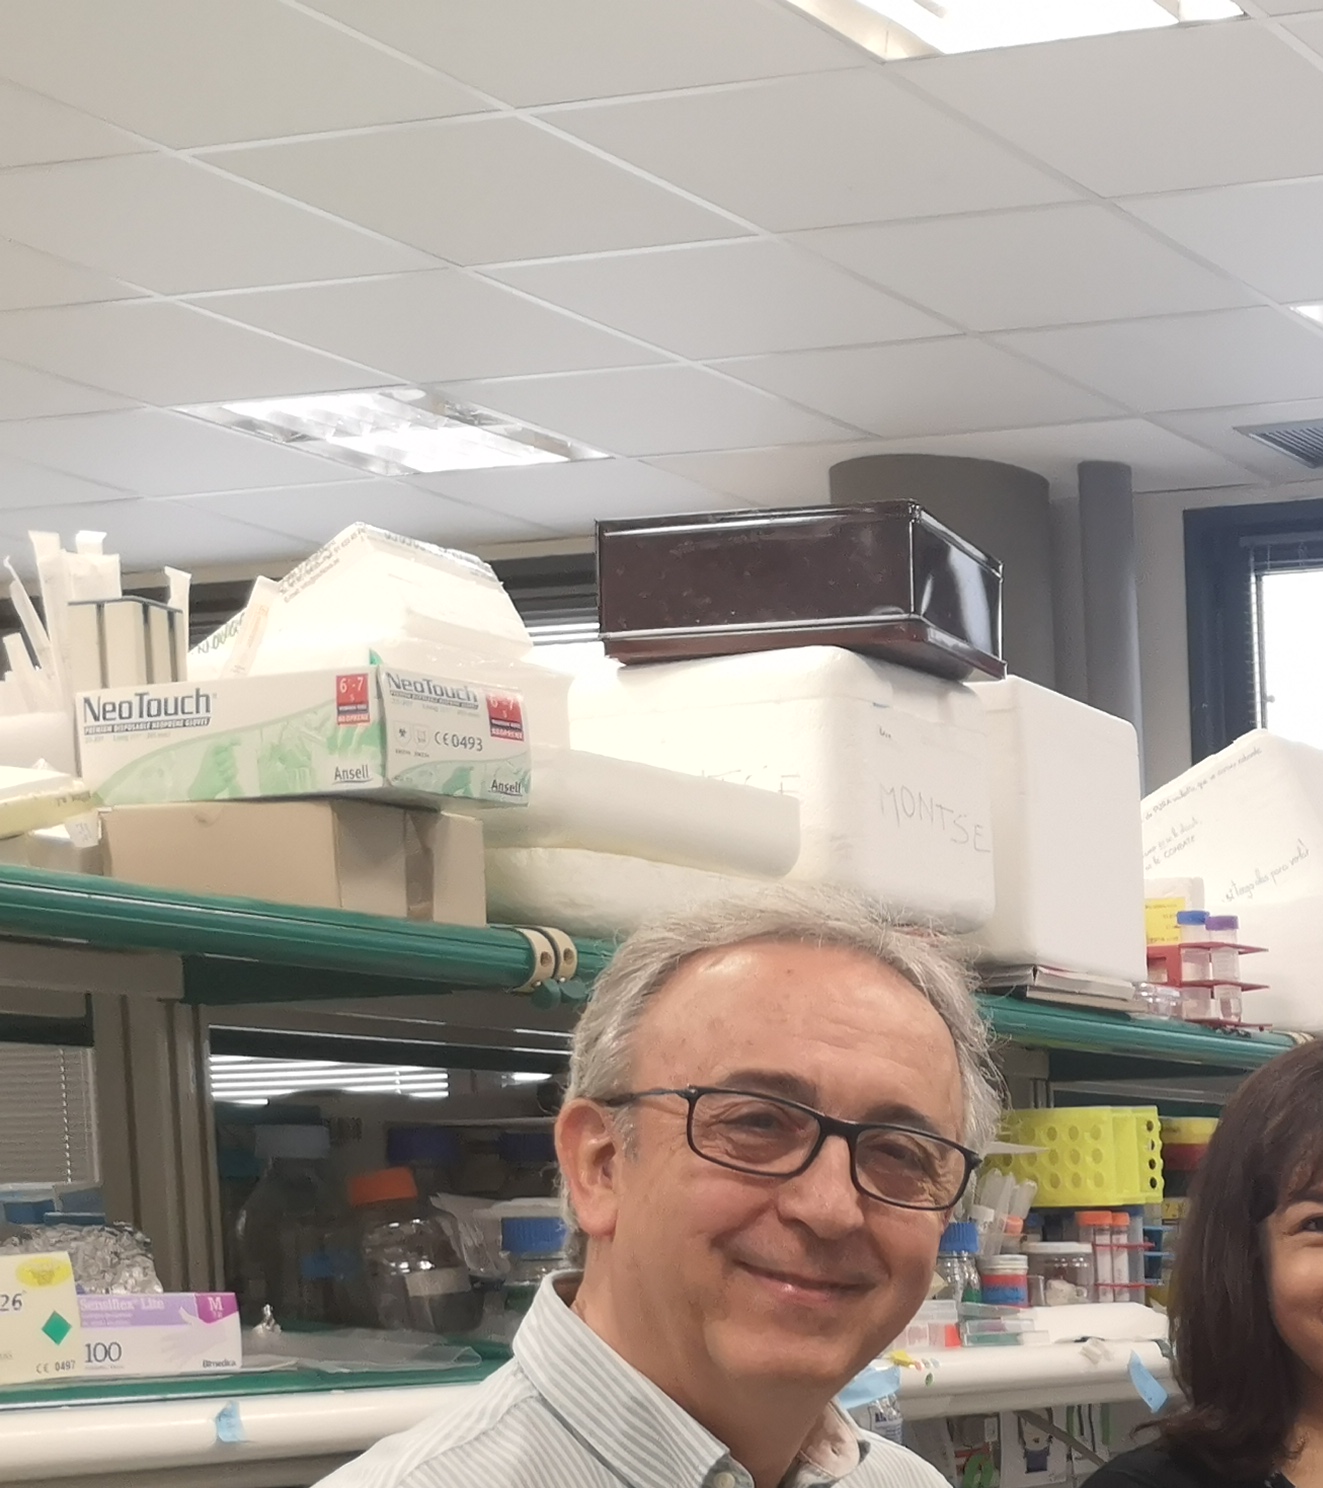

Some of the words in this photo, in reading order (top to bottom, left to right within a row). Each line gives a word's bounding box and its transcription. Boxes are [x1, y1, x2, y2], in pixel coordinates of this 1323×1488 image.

[386, 671, 478, 703] NeoTouch
[83, 688, 210, 723] NeoTouch
[334, 764, 371, 781] Ansell
[491, 779, 522, 794] Ansell
[880, 783, 990, 852] MONTSE
[208, 1296, 224, 1311] M
[85, 1342, 122, 1364] 100
[55, 1360, 76, 1371] 0497
